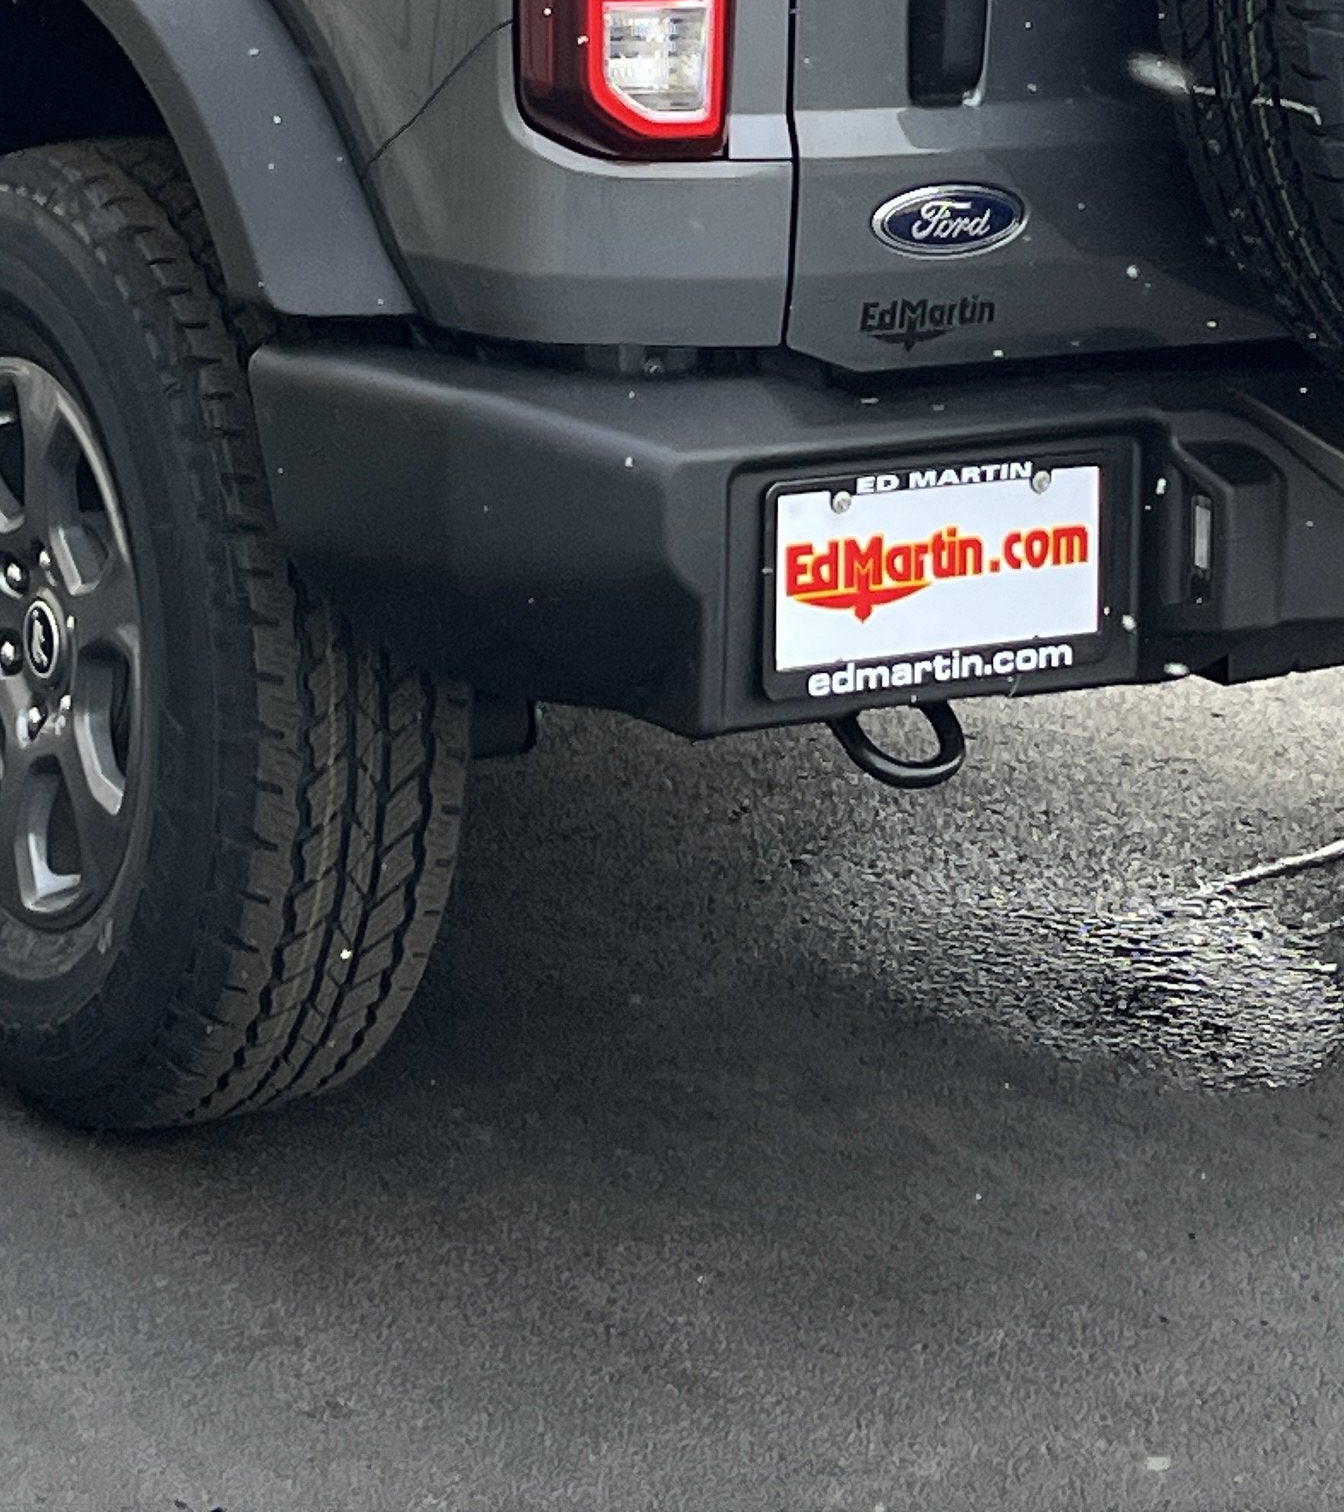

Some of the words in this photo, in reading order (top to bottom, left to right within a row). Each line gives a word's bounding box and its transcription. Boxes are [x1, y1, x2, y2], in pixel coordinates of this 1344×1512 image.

[911, 200, 990, 242] Ford
[860, 294, 995, 348] EdMartin
[856, 474, 900, 494] ED
[909, 462, 1032, 490] MARTIN
[786, 525, 1088, 621] EdMartin.com
[808, 641, 1073, 697] edmartin.com
